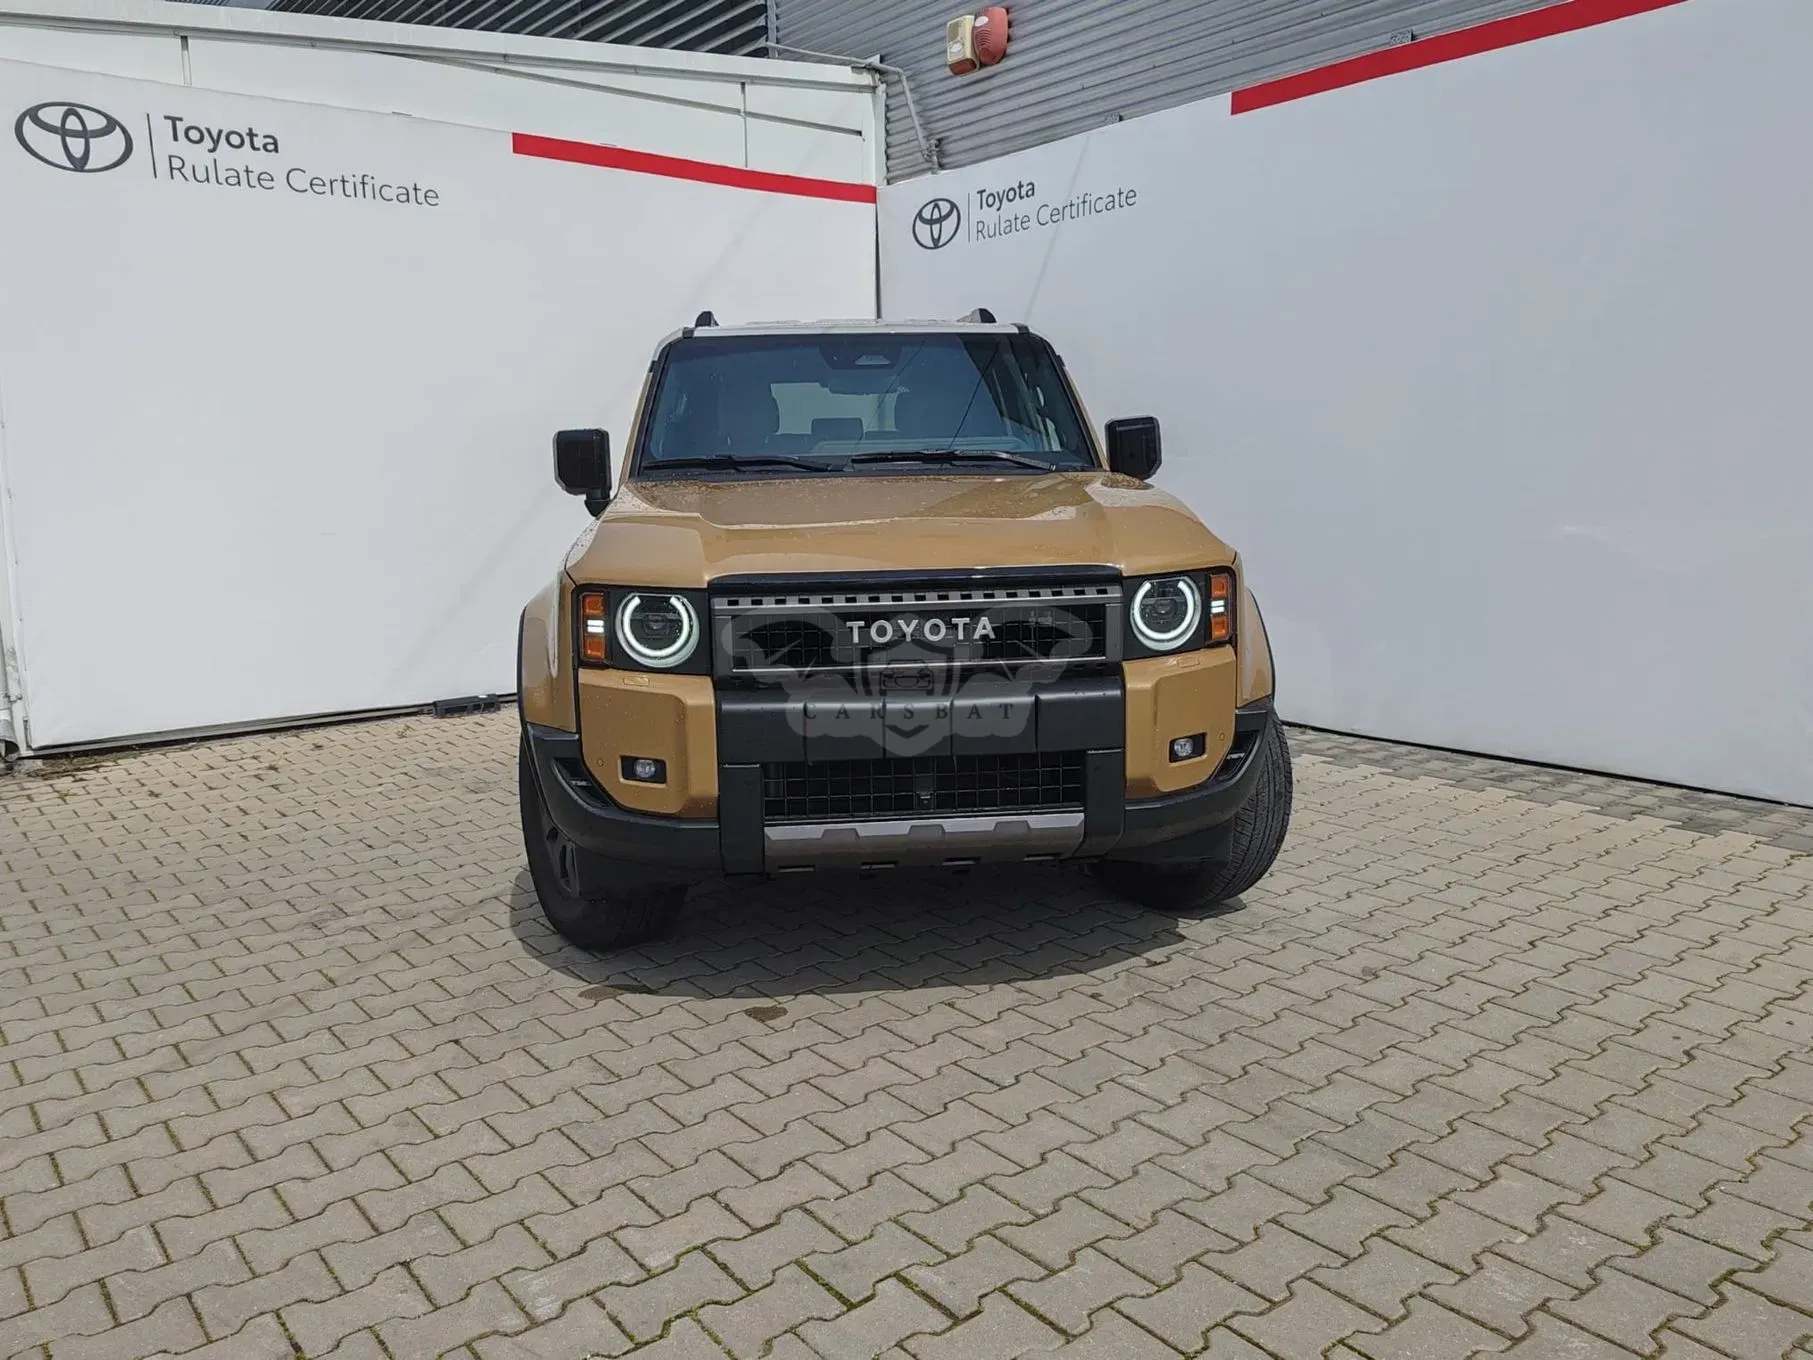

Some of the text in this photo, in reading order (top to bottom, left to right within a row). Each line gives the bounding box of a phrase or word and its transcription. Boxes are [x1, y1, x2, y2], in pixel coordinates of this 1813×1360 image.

[164, 115, 280, 154] Toyota
[168, 154, 440, 207] Rulate Certificate
[977, 181, 1036, 211] Toyota
[976, 187, 1138, 241] Rulate Certificate
[846, 616, 997, 644] TOYOTA
